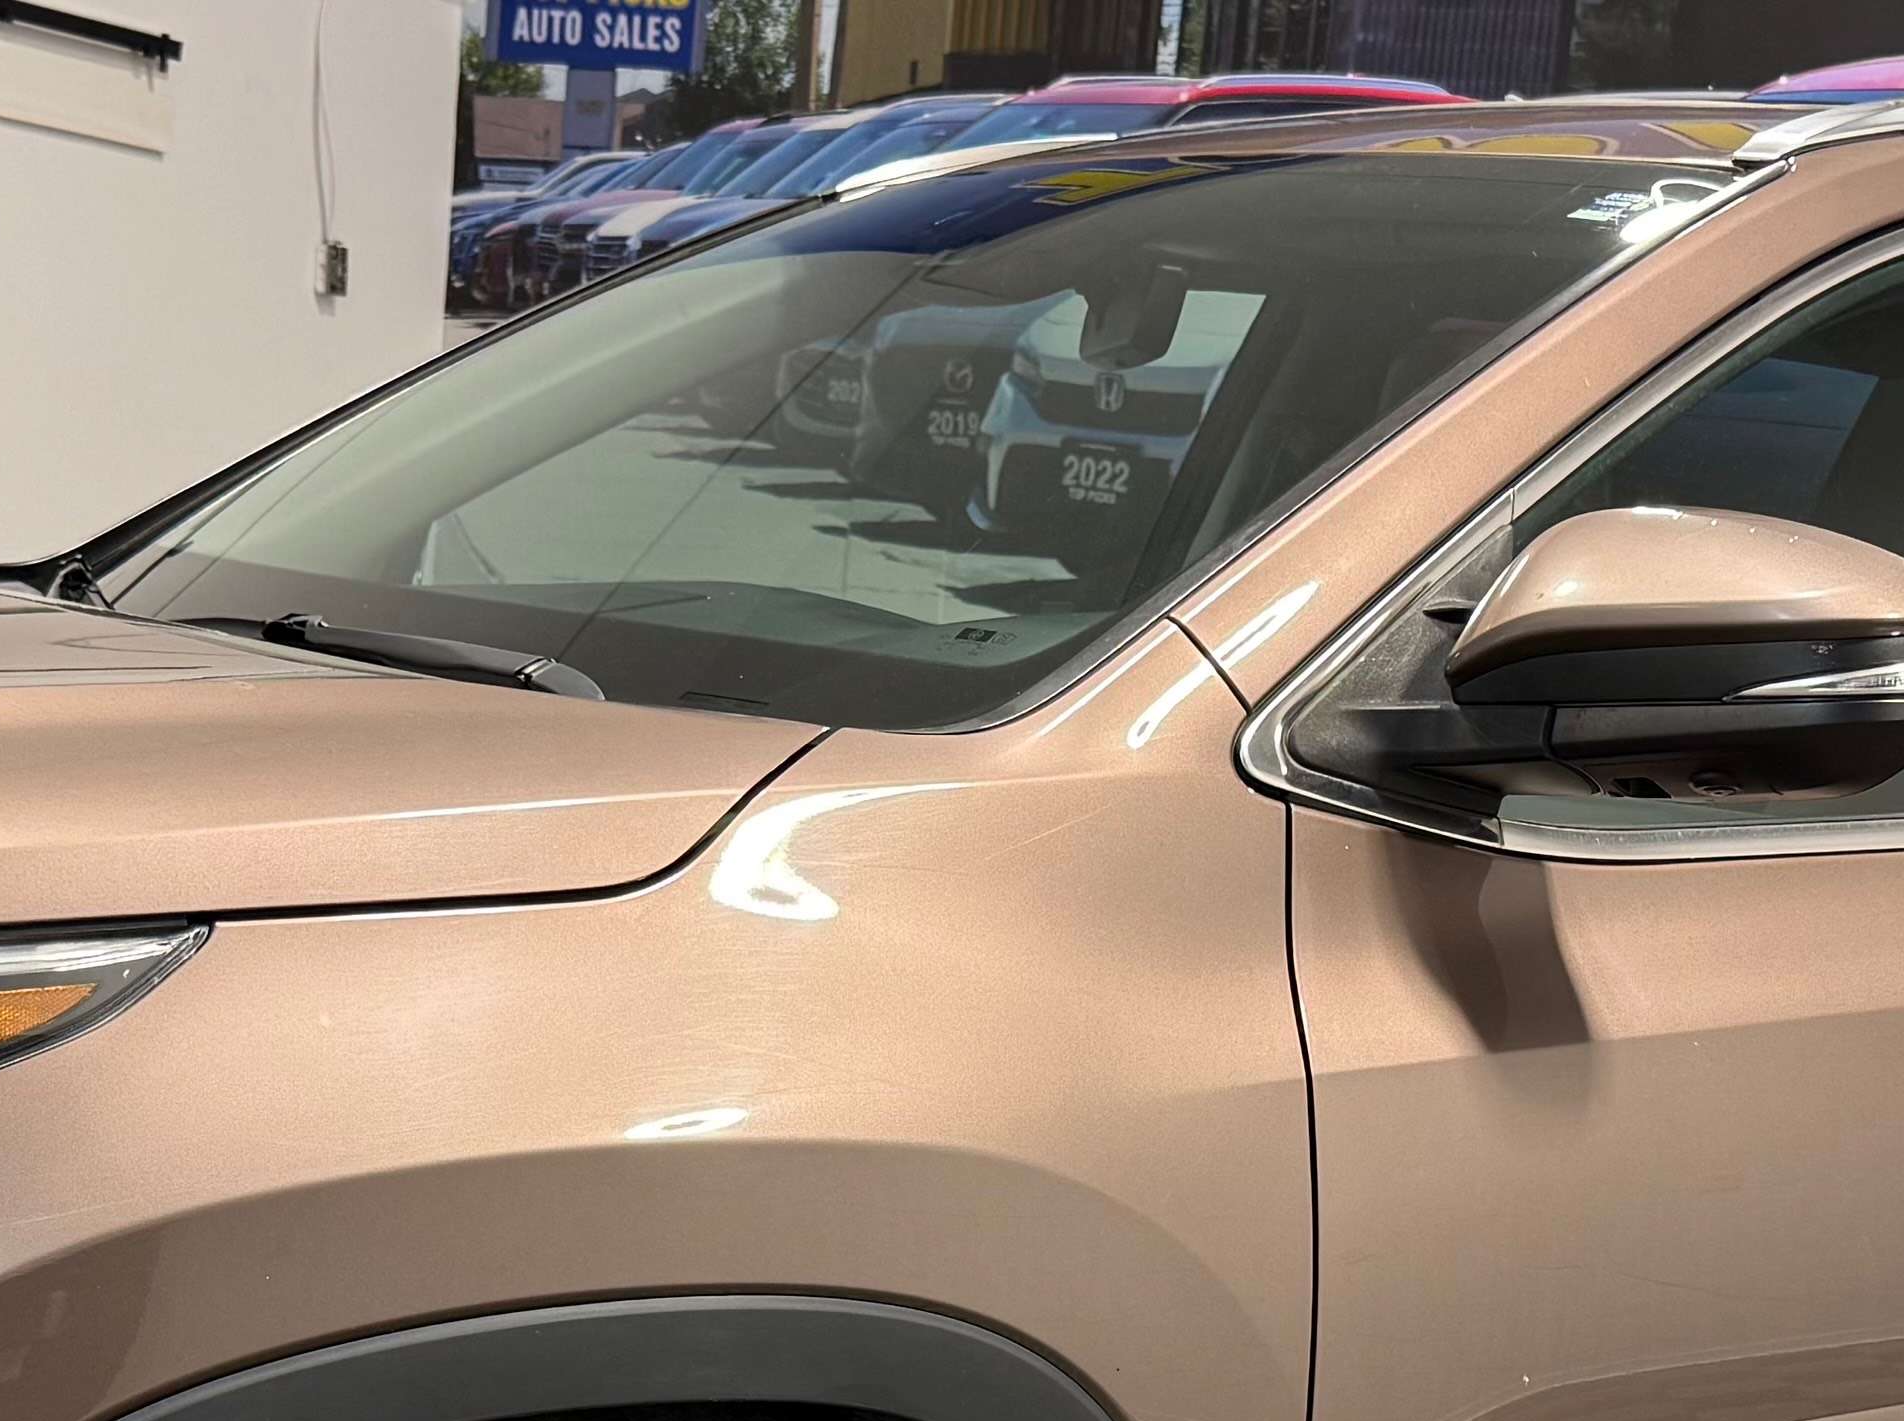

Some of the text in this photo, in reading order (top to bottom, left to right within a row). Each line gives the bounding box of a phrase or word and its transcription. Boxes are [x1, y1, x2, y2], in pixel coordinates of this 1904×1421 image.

[512, 6, 683, 53] AUTO SALES
[928, 410, 979, 436] 2019
[1062, 455, 1130, 493] 2022
